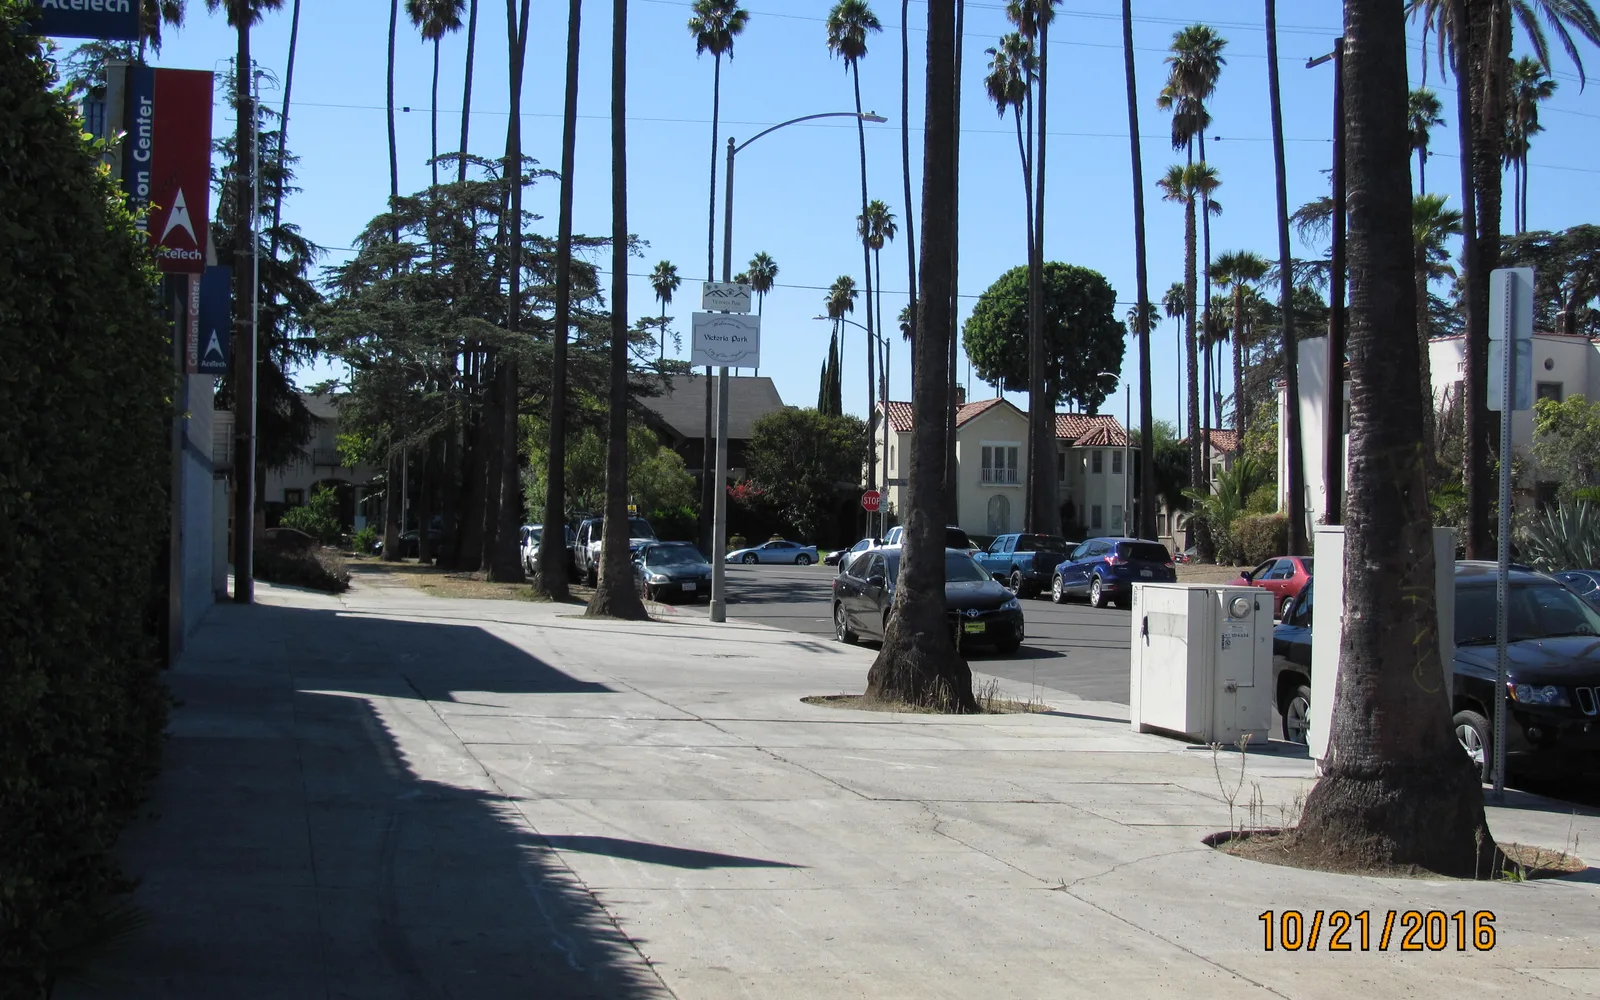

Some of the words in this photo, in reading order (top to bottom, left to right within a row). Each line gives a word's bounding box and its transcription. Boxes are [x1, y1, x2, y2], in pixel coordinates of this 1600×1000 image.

[133, 96, 152, 162] Center
[190, 280, 200, 316] Center
[188, 320, 199, 366] Collision
[704, 333, 729, 342] Victoria
[731, 335, 748, 343] Park
[201, 360, 227, 368] AceTech
[863, 496, 880, 505] STOP
